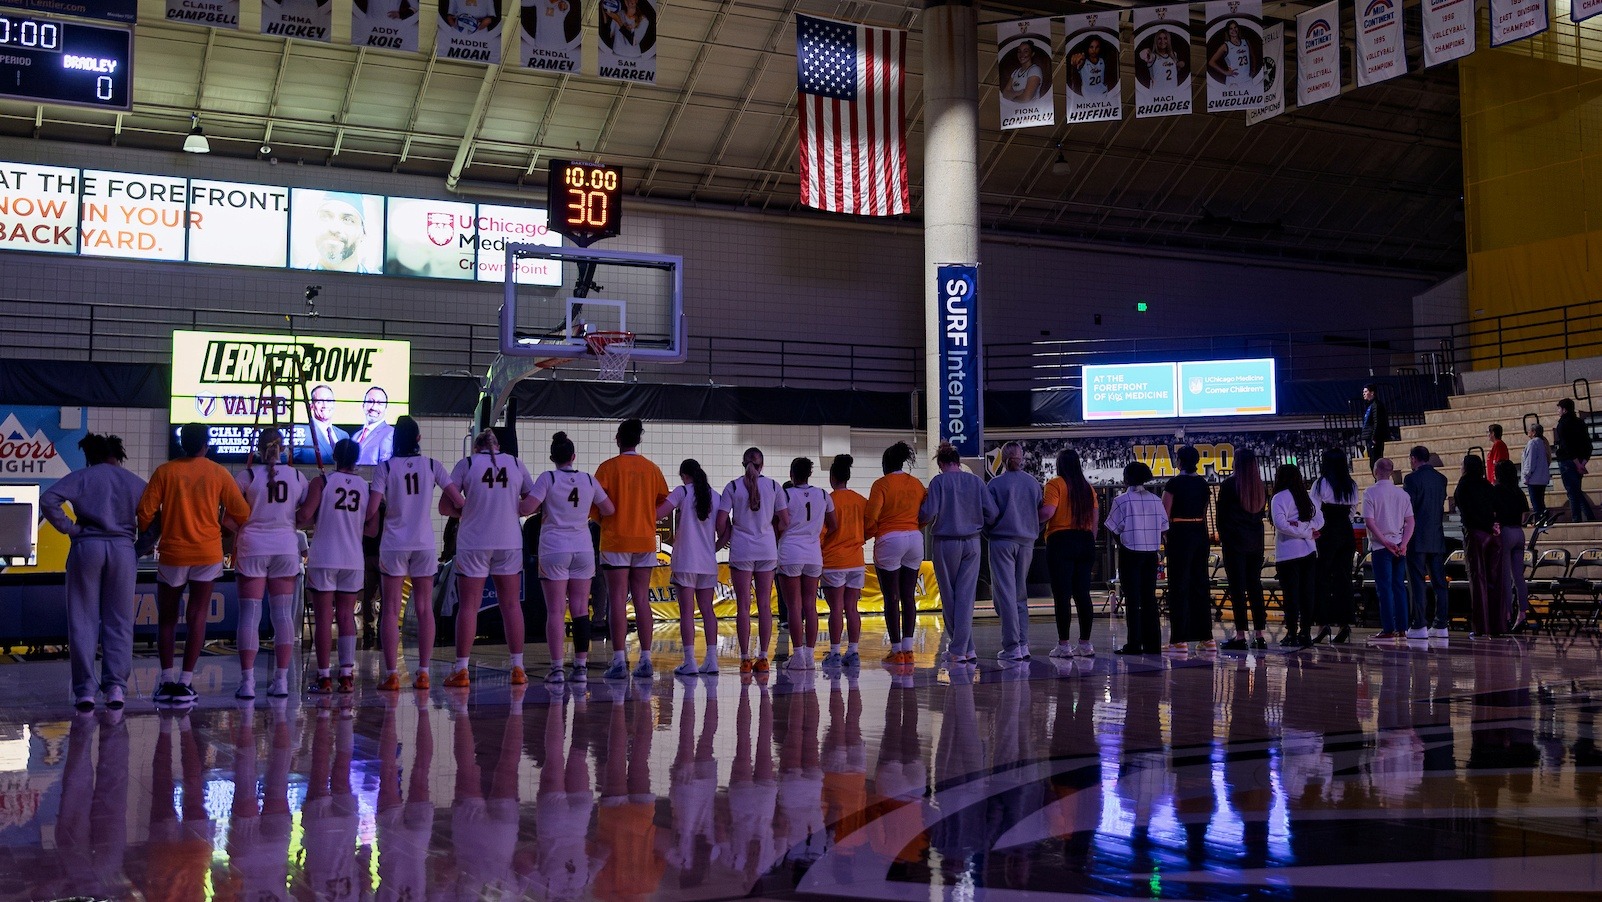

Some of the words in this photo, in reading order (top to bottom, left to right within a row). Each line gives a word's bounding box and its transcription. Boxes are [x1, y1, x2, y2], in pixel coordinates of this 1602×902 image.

[183, 0, 223, 12] CLAIRE
[1373, 6, 1385, 16] MID
[1500, 12, 1512, 23] EAST
[1517, 4, 1540, 17] DIVISION
[166, 8, 237, 25] CAMPBELL
[281, 14, 312, 25] EMMA
[1364, 11, 1395, 29] CONTINENT
[267, 22, 326, 39] HICKEY
[371, 26, 399, 36] ADDY
[1432, 24, 1467, 40] VOLLEYBALL
[1503, 19, 1535, 35] CHAMPIONS
[367, 34, 403, 49] KOIS
[451, 37, 488, 49] MADDIE
[1305, 34, 1332, 49] CONTINENT
[1434, 38, 1466, 54] CHAMPIONS
[0, 55, 32, 67] PERIOD
[447, 46, 491, 61] MOAN
[532, 48, 570, 59] KENDAL
[1237, 55, 1248, 66] 23
[1366, 46, 1395, 61] VOLLEYBALL
[63, 54, 117, 73] BRADLEY
[527, 57, 575, 71] RAMEY
[617, 60, 637, 68] SAM
[1368, 60, 1394, 74] CHAMPIONS
[599, 66, 655, 82] WARREN
[1089, 75, 1101, 86] 20
[1165, 69, 1172, 81] 2
[1307, 67, 1332, 80] VOLLEYBALL
[97, 75, 113, 100] 0
[1222, 89, 1250, 97] BELLA
[1307, 82, 1331, 94] CHAMPIONS
[1076, 101, 1112, 109] MIKAYLA
[1153, 95, 1174, 103] MACI
[1208, 95, 1263, 109] SWEDLUND
[1014, 107, 1039, 115] FIONA
[1069, 107, 1119, 121] HUFFINE
[1137, 100, 1190, 115] RHOADES
[1250, 101, 1281, 119] CHAMPIONS
[1002, 112, 1054, 127] CONNOLLY
[565, 167, 617, 190] 10.00
[38, 173, 97, 196] THE
[108, 179, 289, 212] FOREFRONT.
[567, 188, 608, 226] 30
[82, 203, 108, 222] IN
[120, 206, 204, 230] YOUR
[459, 214, 548, 237] UChicago
[511, 262, 548, 275] Point
[946, 278, 968, 347] SURF
[1093, 375, 1106, 383] AT
[1107, 374, 1124, 383] THE
[1205, 375, 1235, 384] UChicago
[1235, 374, 1264, 382] Medicine
[1093, 382, 1148, 392] FOREFRONT
[947, 350, 968, 443] Internet
[1093, 392, 1106, 401] OF
[1125, 390, 1168, 400] MEDICINE
[209, 438, 250, 446] PARAISO
[1132, 442, 1235, 478] VAPO
[404, 472, 419, 495] 11
[481, 467, 508, 488] 44
[267, 480, 288, 504] 10
[334, 487, 361, 512] 23
[568, 487, 579, 507] 4
[805, 502, 811, 522] 1
